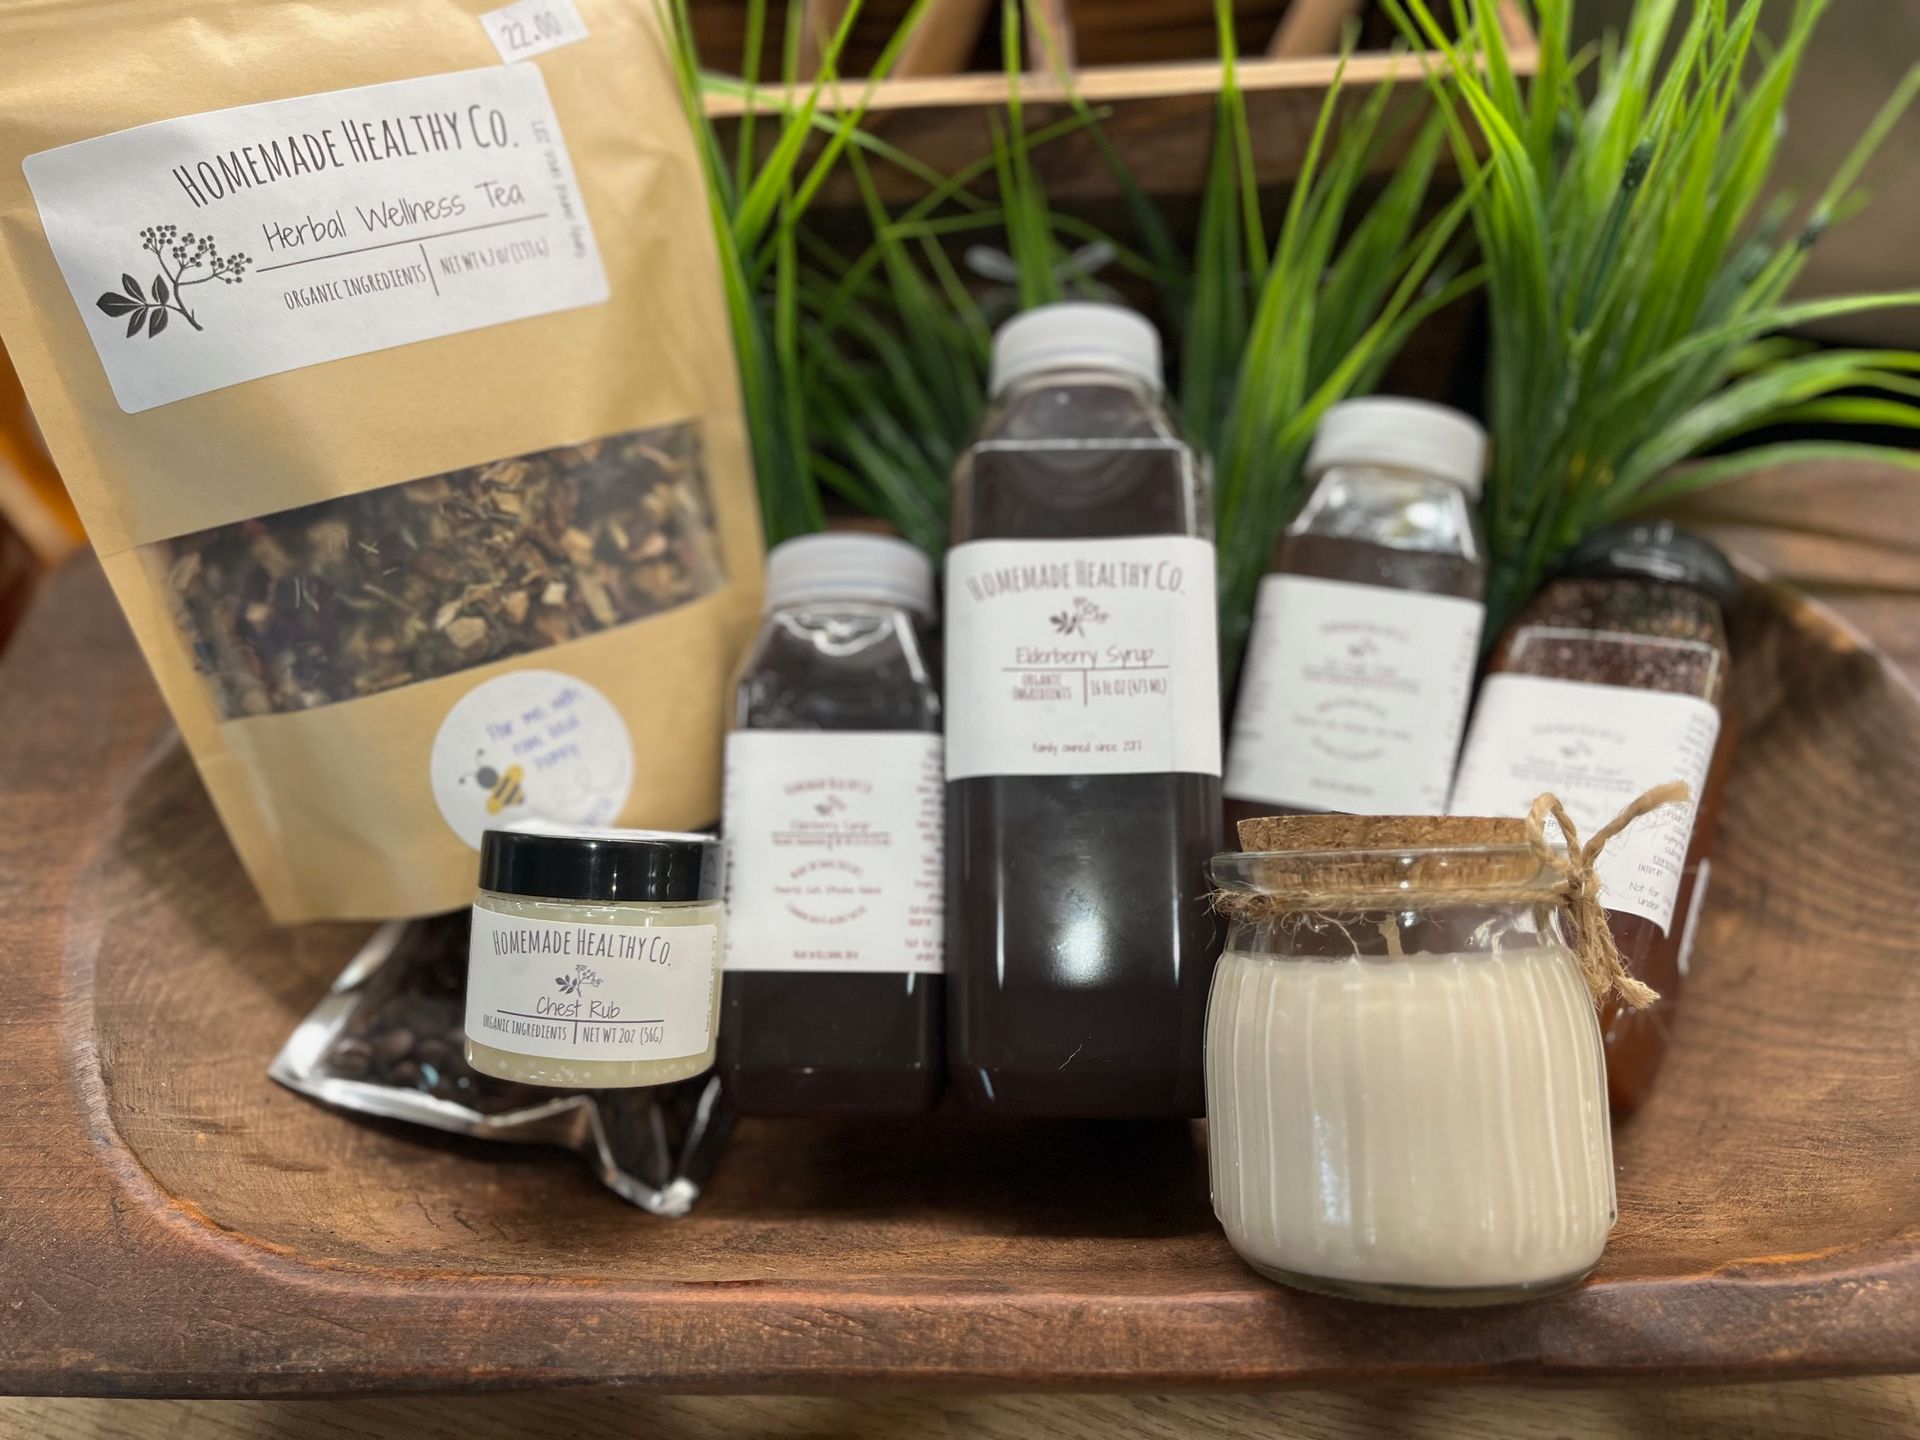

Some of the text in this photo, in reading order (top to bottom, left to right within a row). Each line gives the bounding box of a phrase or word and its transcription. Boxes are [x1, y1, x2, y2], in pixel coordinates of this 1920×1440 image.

[501, 10, 562, 50] 22.00
[172, 129, 344, 208] HOMEMADE
[341, 111, 462, 163] HEALTHY
[262, 179, 526, 252] Herbal Wellness Tea
[283, 281, 344, 311] ORGANIC
[343, 263, 427, 297] INGREDIENTS
[440, 255, 462, 276] NET
[965, 562, 1070, 602] HOMEMADE
[1074, 558, 1152, 590] HEALTHY
[1015, 645, 1155, 670] Elderberry Syrup
[1628, 881, 1645, 893] Not
[492, 929, 571, 956] HOMEMADE
[577, 928, 646, 960] HEALTHY
[536, 996, 621, 1019] Chest Rub
[482, 1014, 510, 1034] ORGANIC
[511, 1020, 567, 1041] INGREDIENTS
[583, 1027, 599, 1043] NET
[600, 1027, 616, 1043] WT
